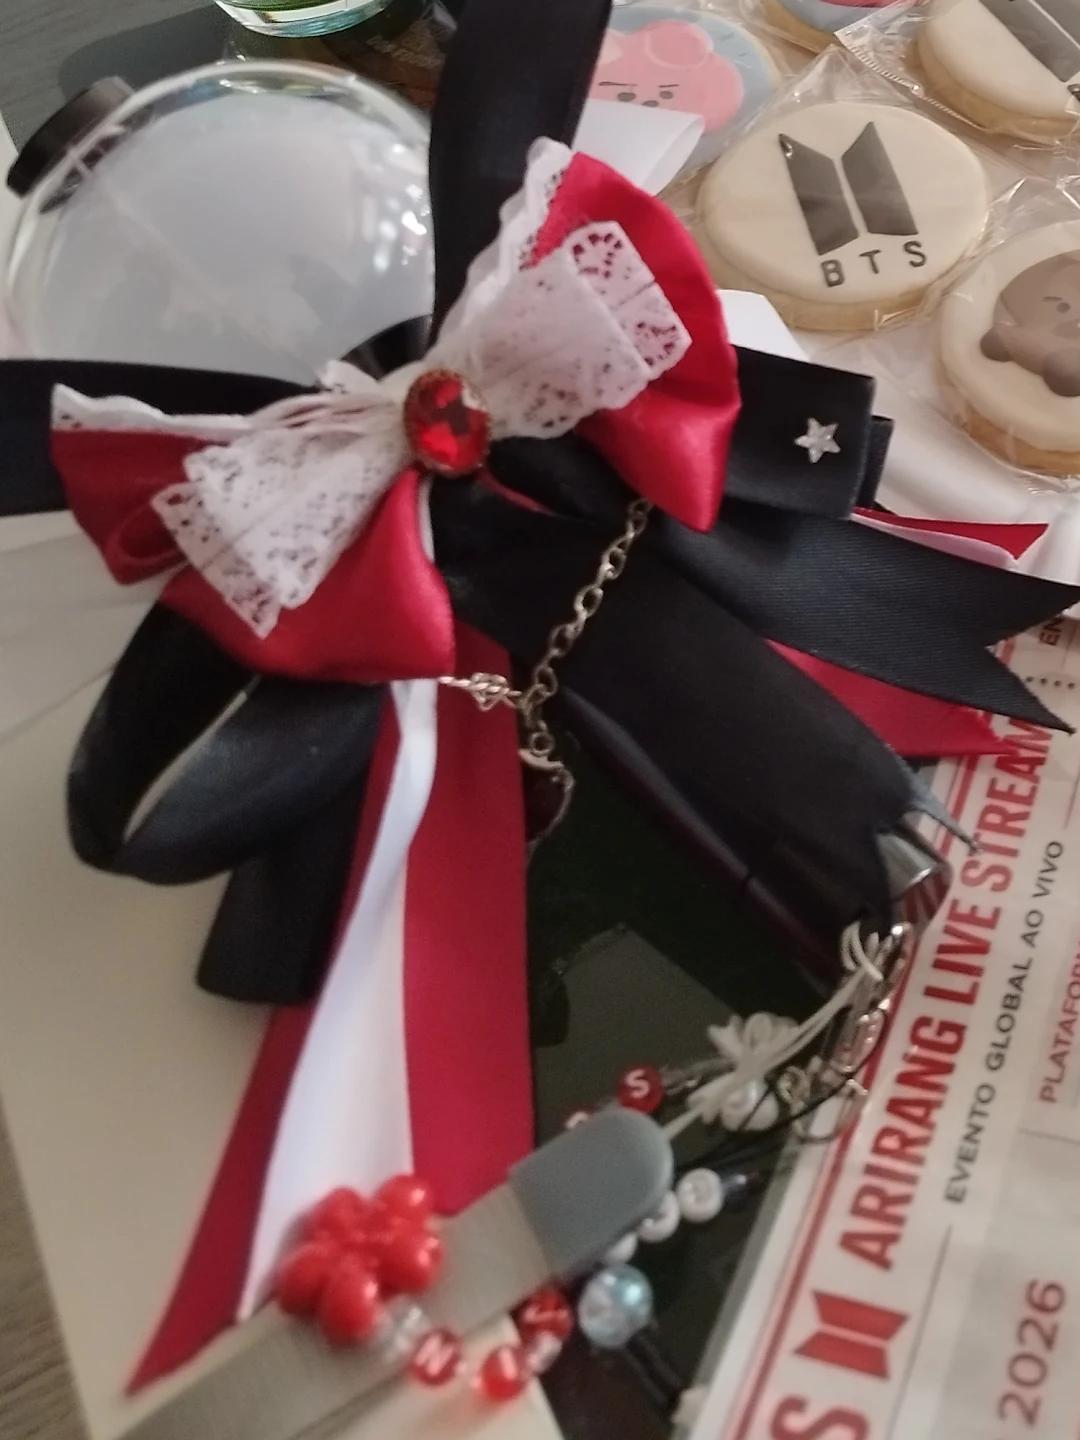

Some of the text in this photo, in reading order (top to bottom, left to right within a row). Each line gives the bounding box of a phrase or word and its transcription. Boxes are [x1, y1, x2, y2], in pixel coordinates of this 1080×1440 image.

[820, 240, 927, 288] BTS
[838, 1014, 968, 1271] ARIRANG
[924, 898, 1002, 1008] LIVE
[944, 839, 1065, 1205] EVENTO GLOBAL AO VIVO
[997, 1279, 1067, 1428] 2026
